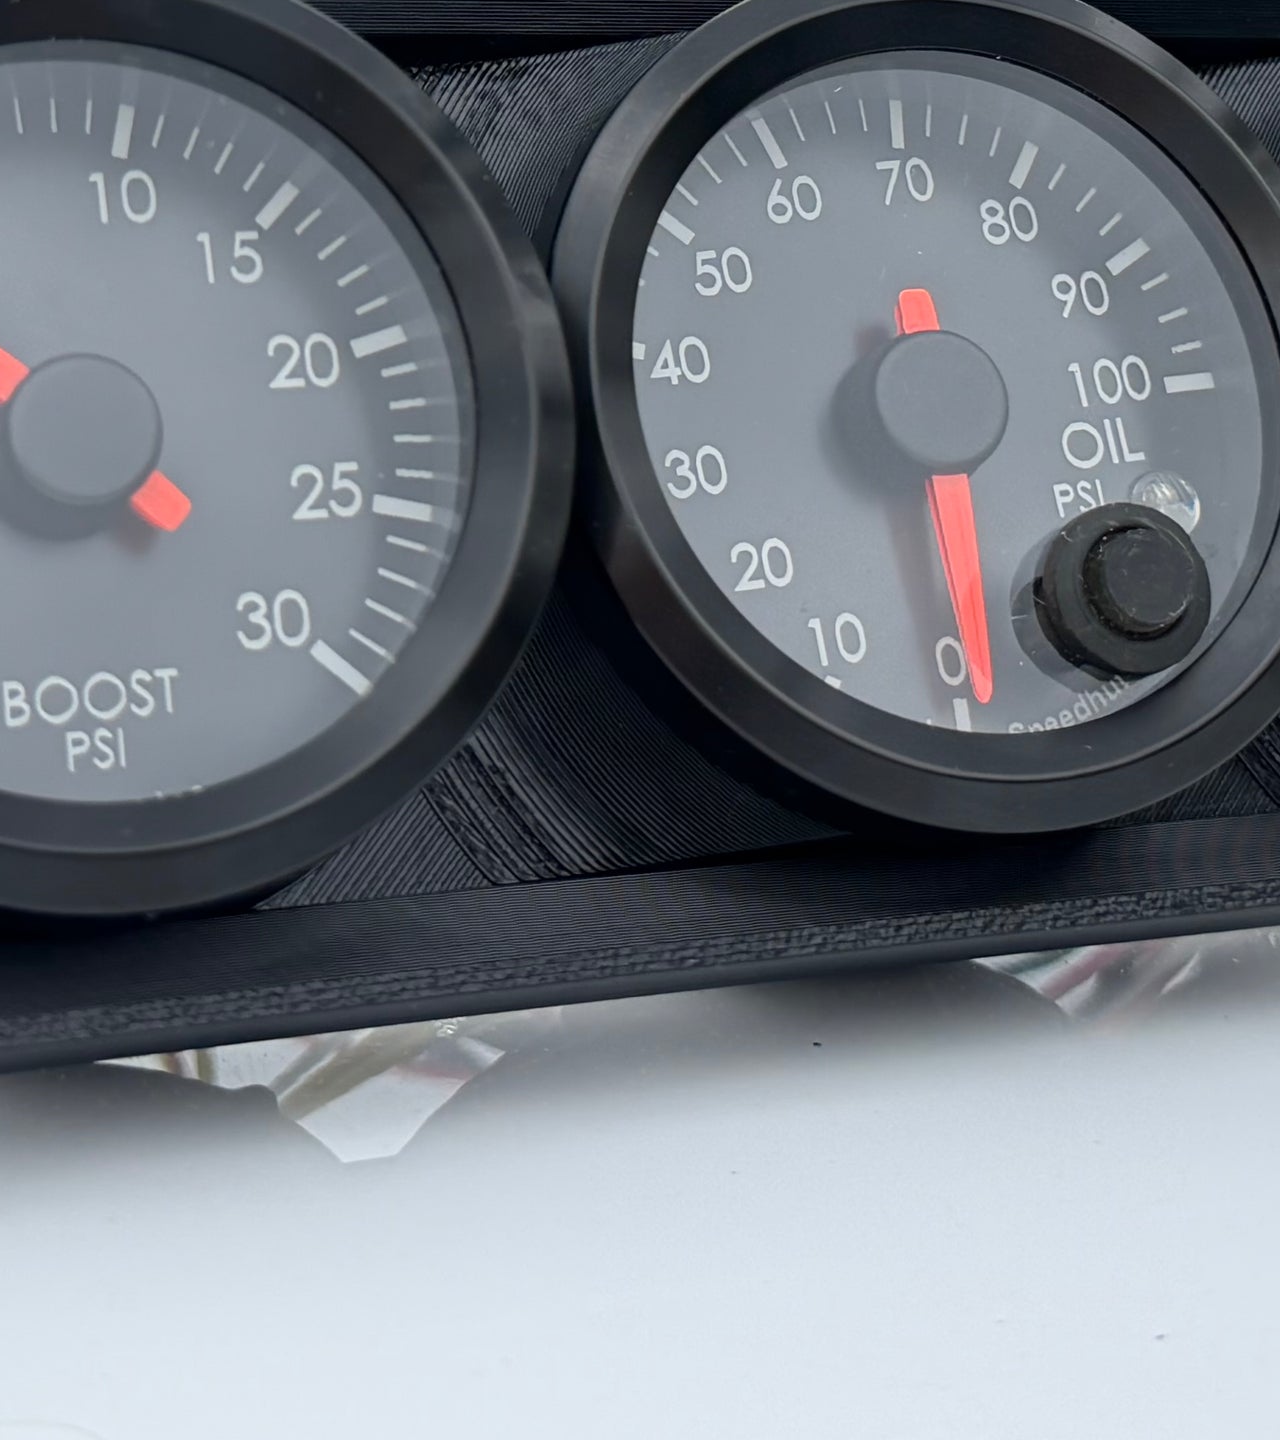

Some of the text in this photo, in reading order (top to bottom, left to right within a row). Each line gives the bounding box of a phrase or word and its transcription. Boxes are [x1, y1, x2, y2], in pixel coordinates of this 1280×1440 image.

[88, 169, 157, 225] 10
[766, 175, 823, 224] 60
[875, 157, 935, 206] 70
[980, 196, 1038, 245] 80
[196, 231, 263, 284] 15
[694, 246, 753, 297] 50
[1051, 270, 1110, 319] 90
[267, 333, 340, 389] 20
[650, 335, 711, 385] 40
[1067, 355, 1151, 408] 100
[1061, 417, 1146, 469] OIL
[290, 461, 363, 521] 25
[664, 445, 728, 499] 30
[1052, 478, 1107, 518] PSI
[730, 537, 794, 592] 20
[236, 588, 311, 651] 30
[807, 612, 867, 667] 10
[935, 636, 966, 687] 0
[2, 667, 179, 728] BOOST
[65, 727, 127, 772] PSI
